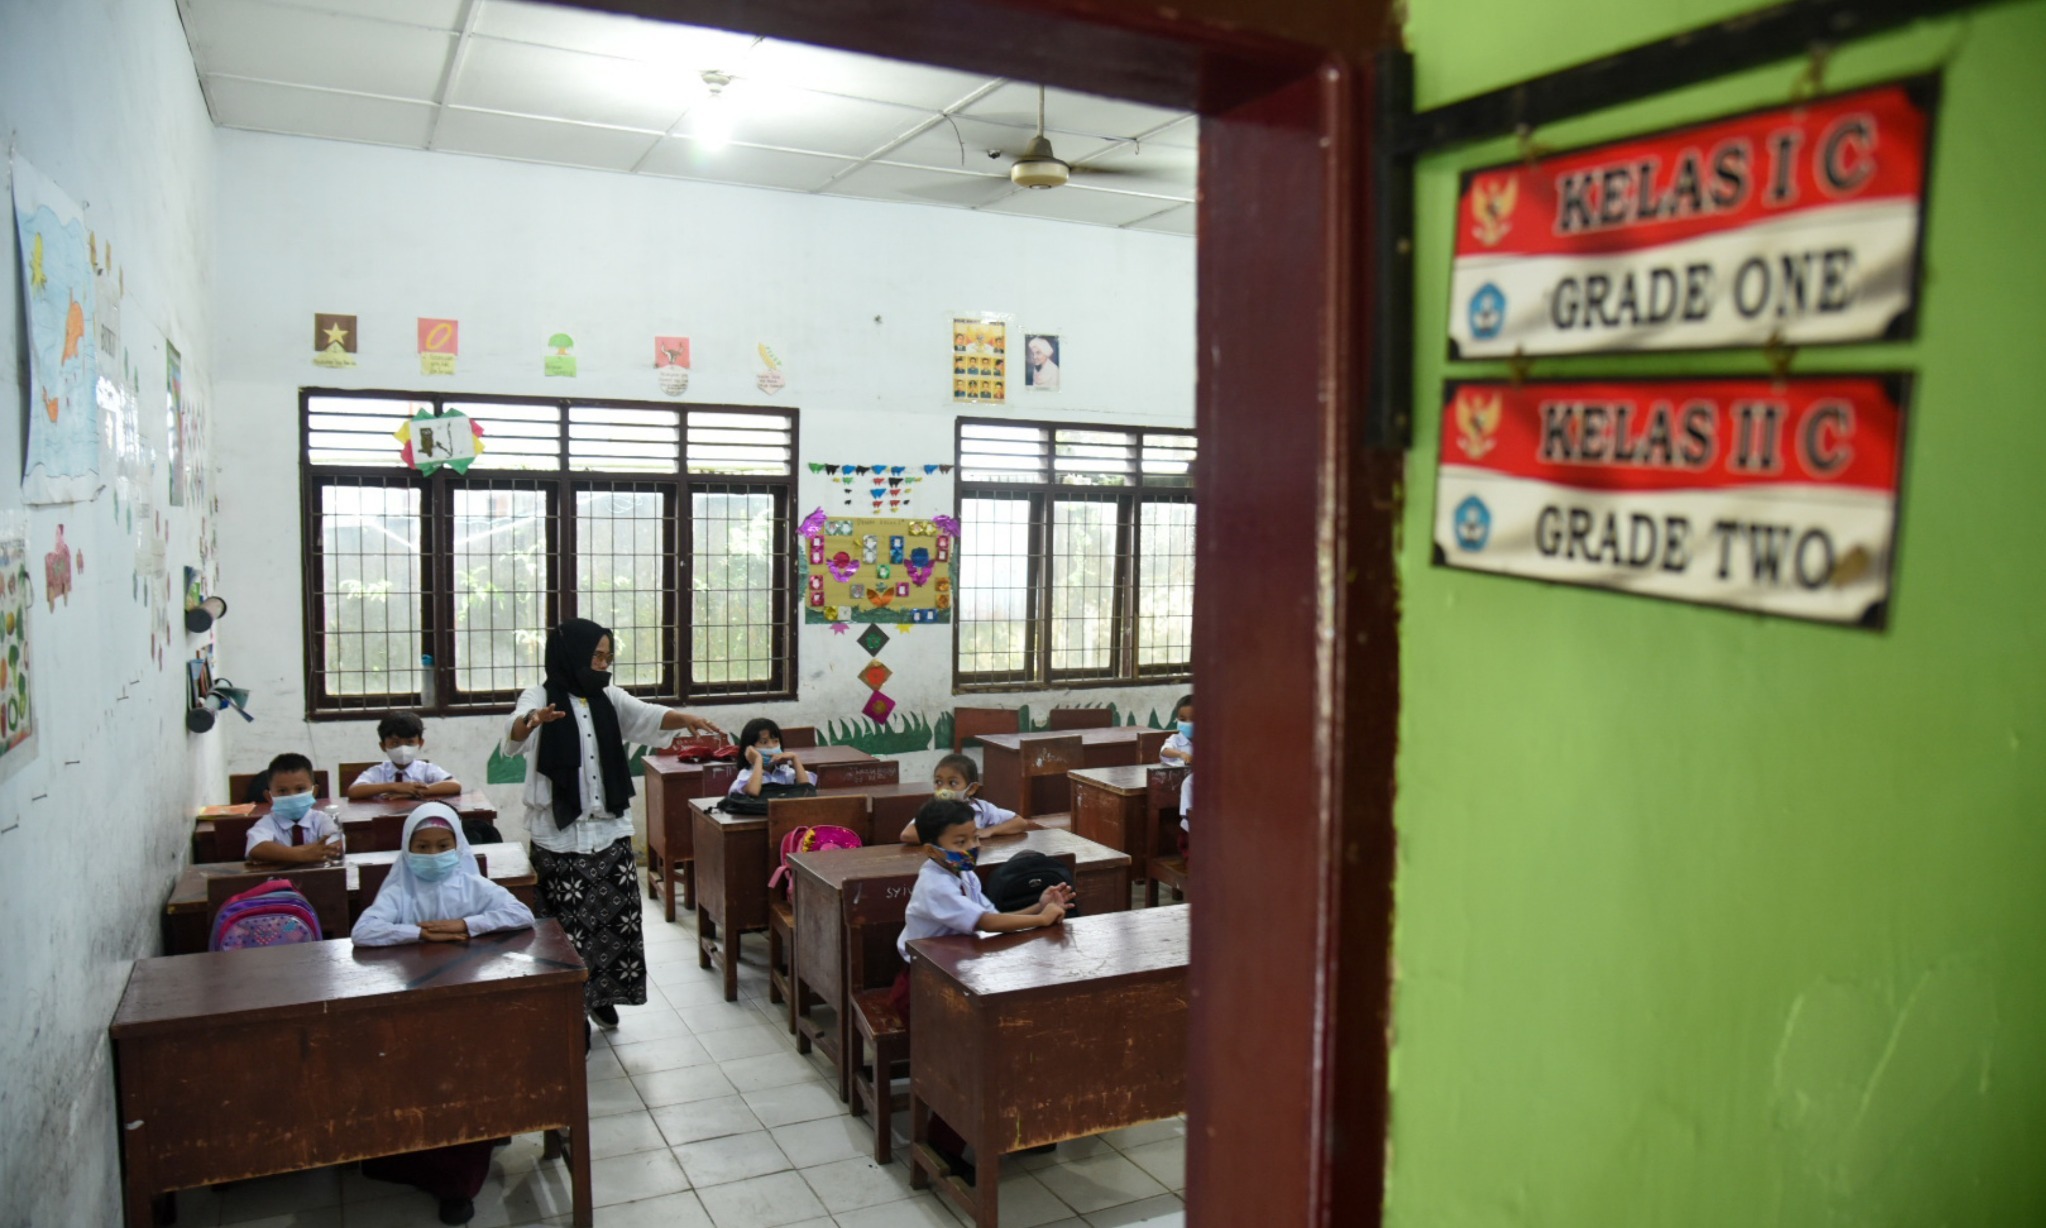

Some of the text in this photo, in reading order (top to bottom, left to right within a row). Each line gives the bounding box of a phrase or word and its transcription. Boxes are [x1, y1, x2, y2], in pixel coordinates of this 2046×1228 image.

[1556, 142, 1751, 234] KELAS
[1818, 117, 1874, 195] C
[1551, 248, 1856, 330] GRADE ONE
[1539, 401, 1853, 475] KELAS II C
[1534, 505, 1835, 590] GRADE TWO
